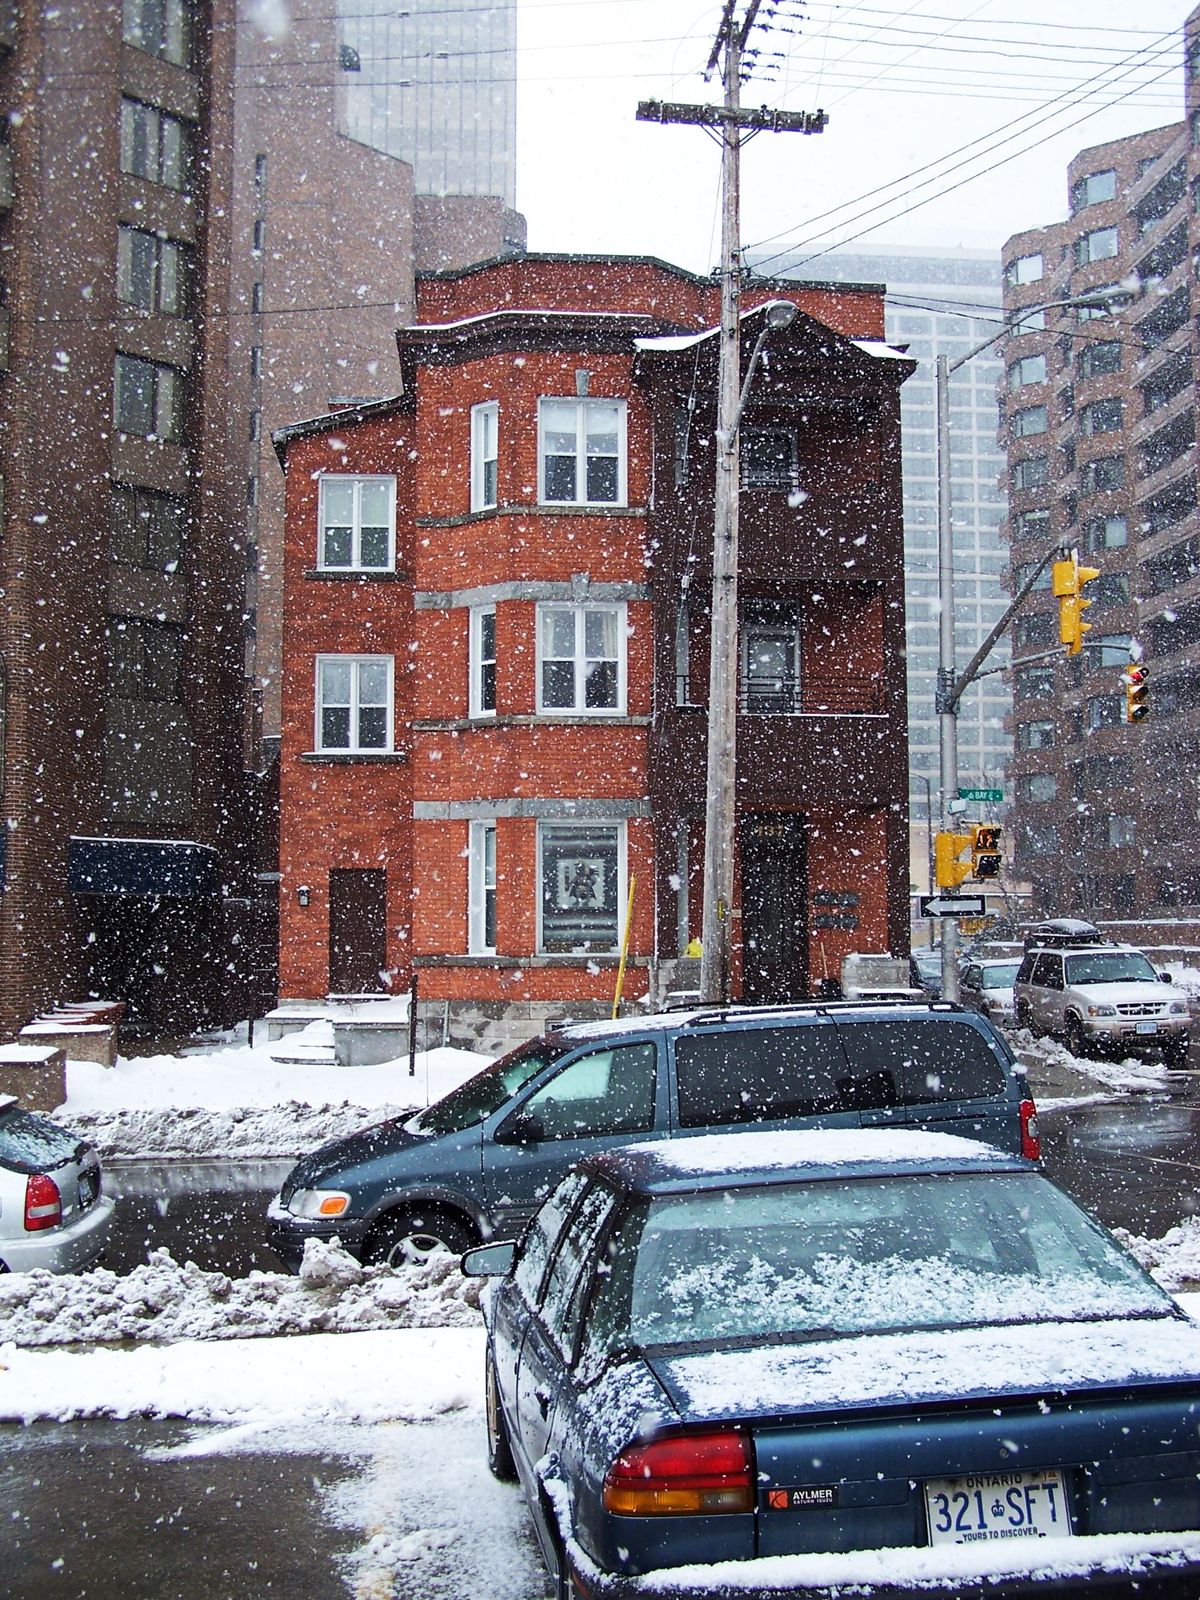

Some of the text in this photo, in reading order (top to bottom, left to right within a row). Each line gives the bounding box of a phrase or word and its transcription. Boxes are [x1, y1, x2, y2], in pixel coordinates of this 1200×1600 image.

[975, 791, 987, 799] BAY
[966, 1473, 1022, 1488] ONTARIO
[793, 1489, 833, 1500] AYLMER
[933, 1483, 1059, 1533] 321 SFT
[962, 1527, 1038, 1542] YOURS TO DISCOVER
